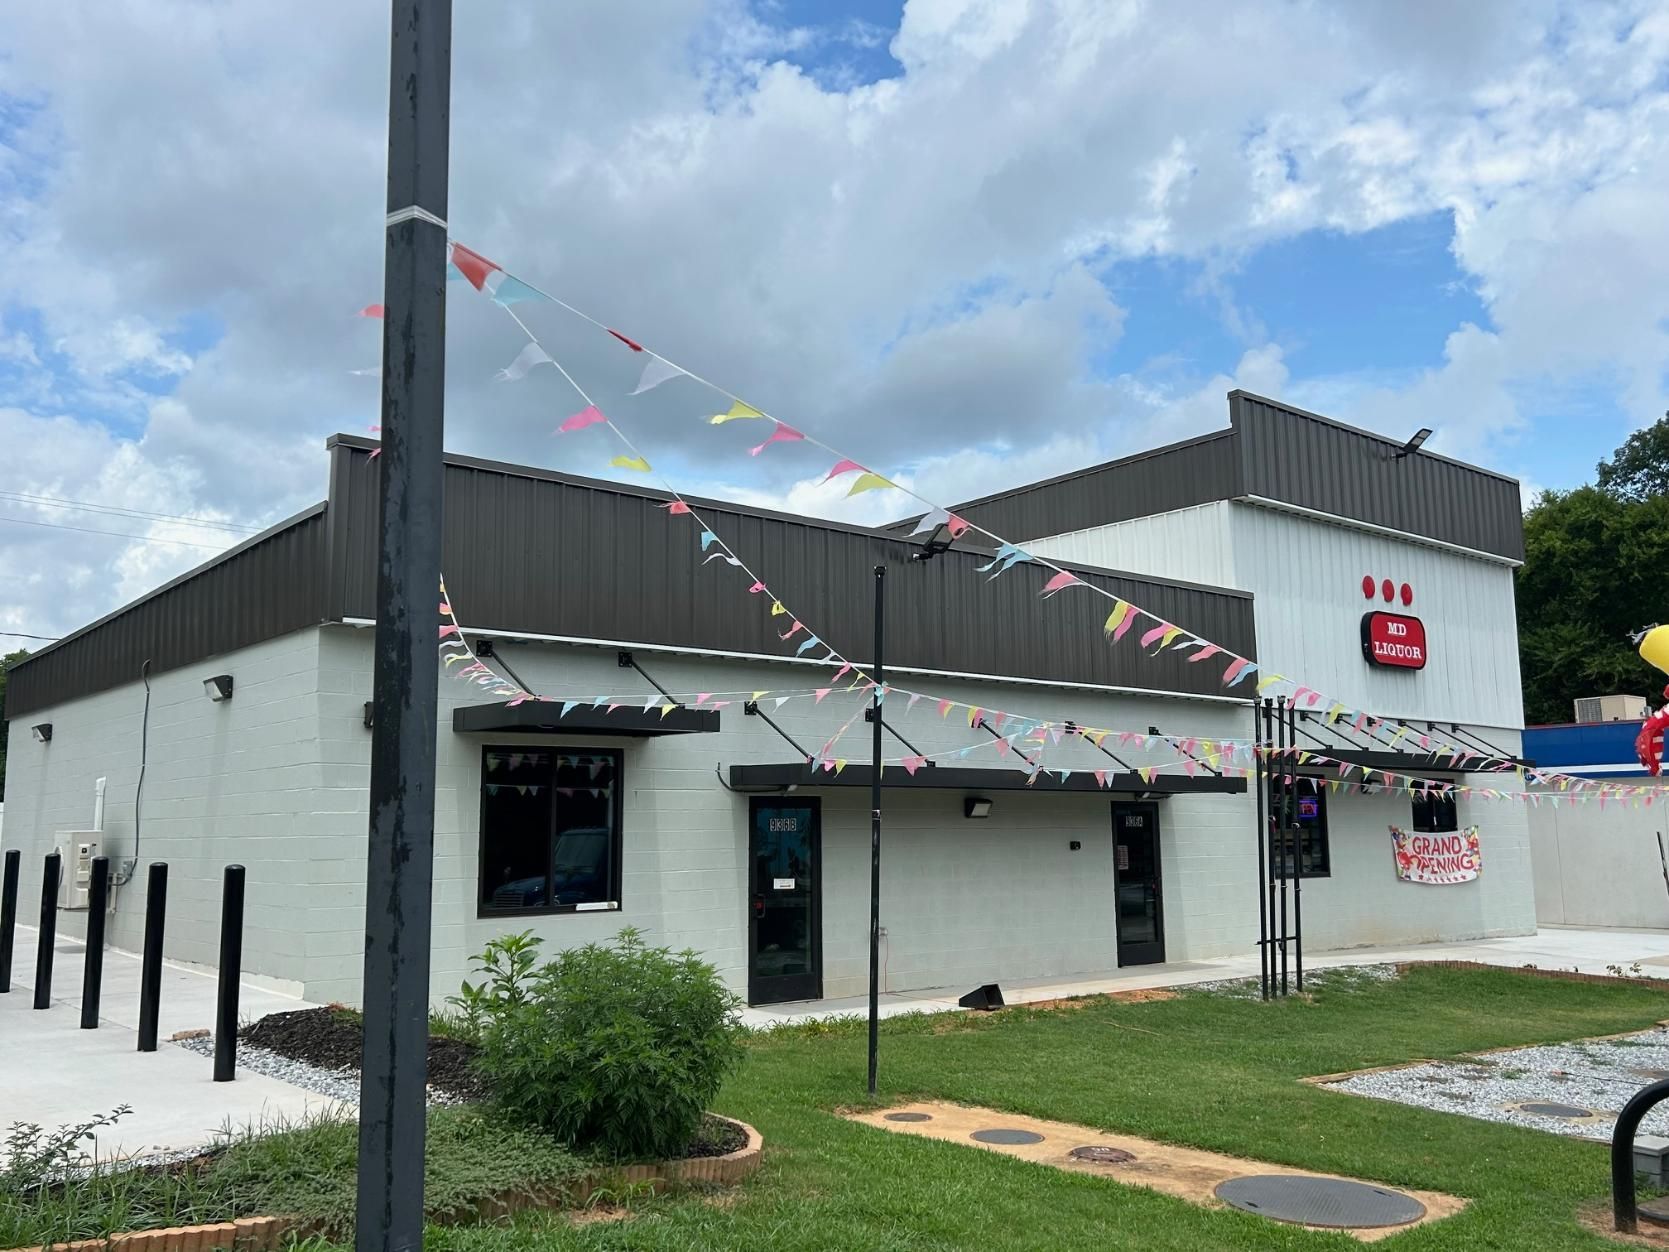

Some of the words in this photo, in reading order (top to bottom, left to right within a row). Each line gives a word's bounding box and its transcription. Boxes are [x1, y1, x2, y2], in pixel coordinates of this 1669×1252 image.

[1387, 622, 1407, 636] MD
[1374, 641, 1422, 659] LIQUOR
[769, 818, 797, 832] 936B
[1412, 836, 1462, 856] GRAND
